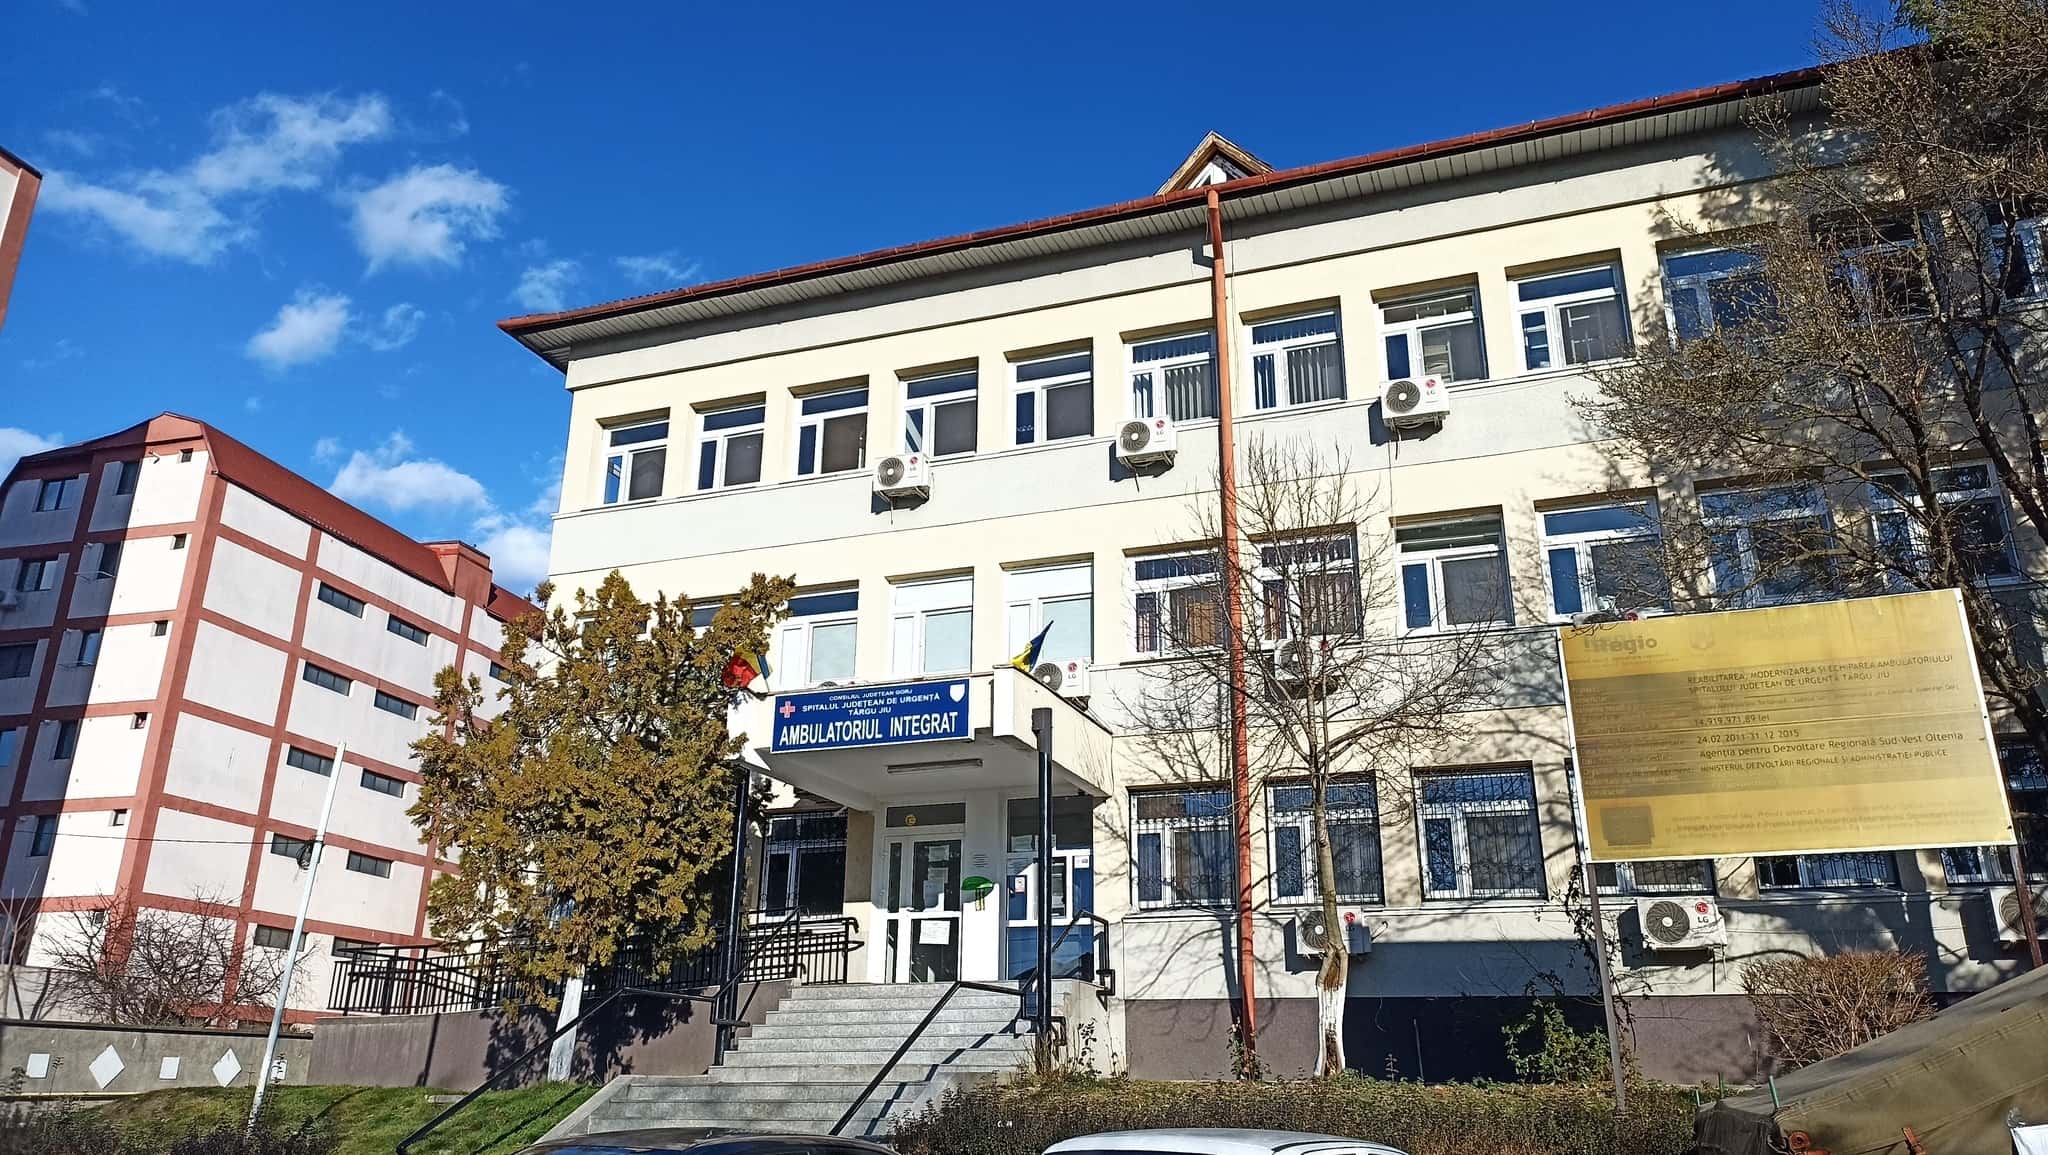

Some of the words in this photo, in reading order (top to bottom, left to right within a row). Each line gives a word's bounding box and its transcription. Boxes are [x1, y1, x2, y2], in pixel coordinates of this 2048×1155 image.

[1785, 678, 1796, 687] DE
[802, 702, 839, 712] SPITALUL
[886, 697, 897, 705] DE
[878, 706, 892, 714] JIU
[1758, 713, 1770, 721] lei
[779, 718, 883, 746] AMBULATORIUL
[890, 712, 958, 737] INTEGRAT
[1738, 746, 1771, 757] pentru
[1773, 742, 1826, 753] Dezvoltare
[1925, 732, 1963, 742] Oltenia
[1914, 749, 1948, 759] PUBLICE
